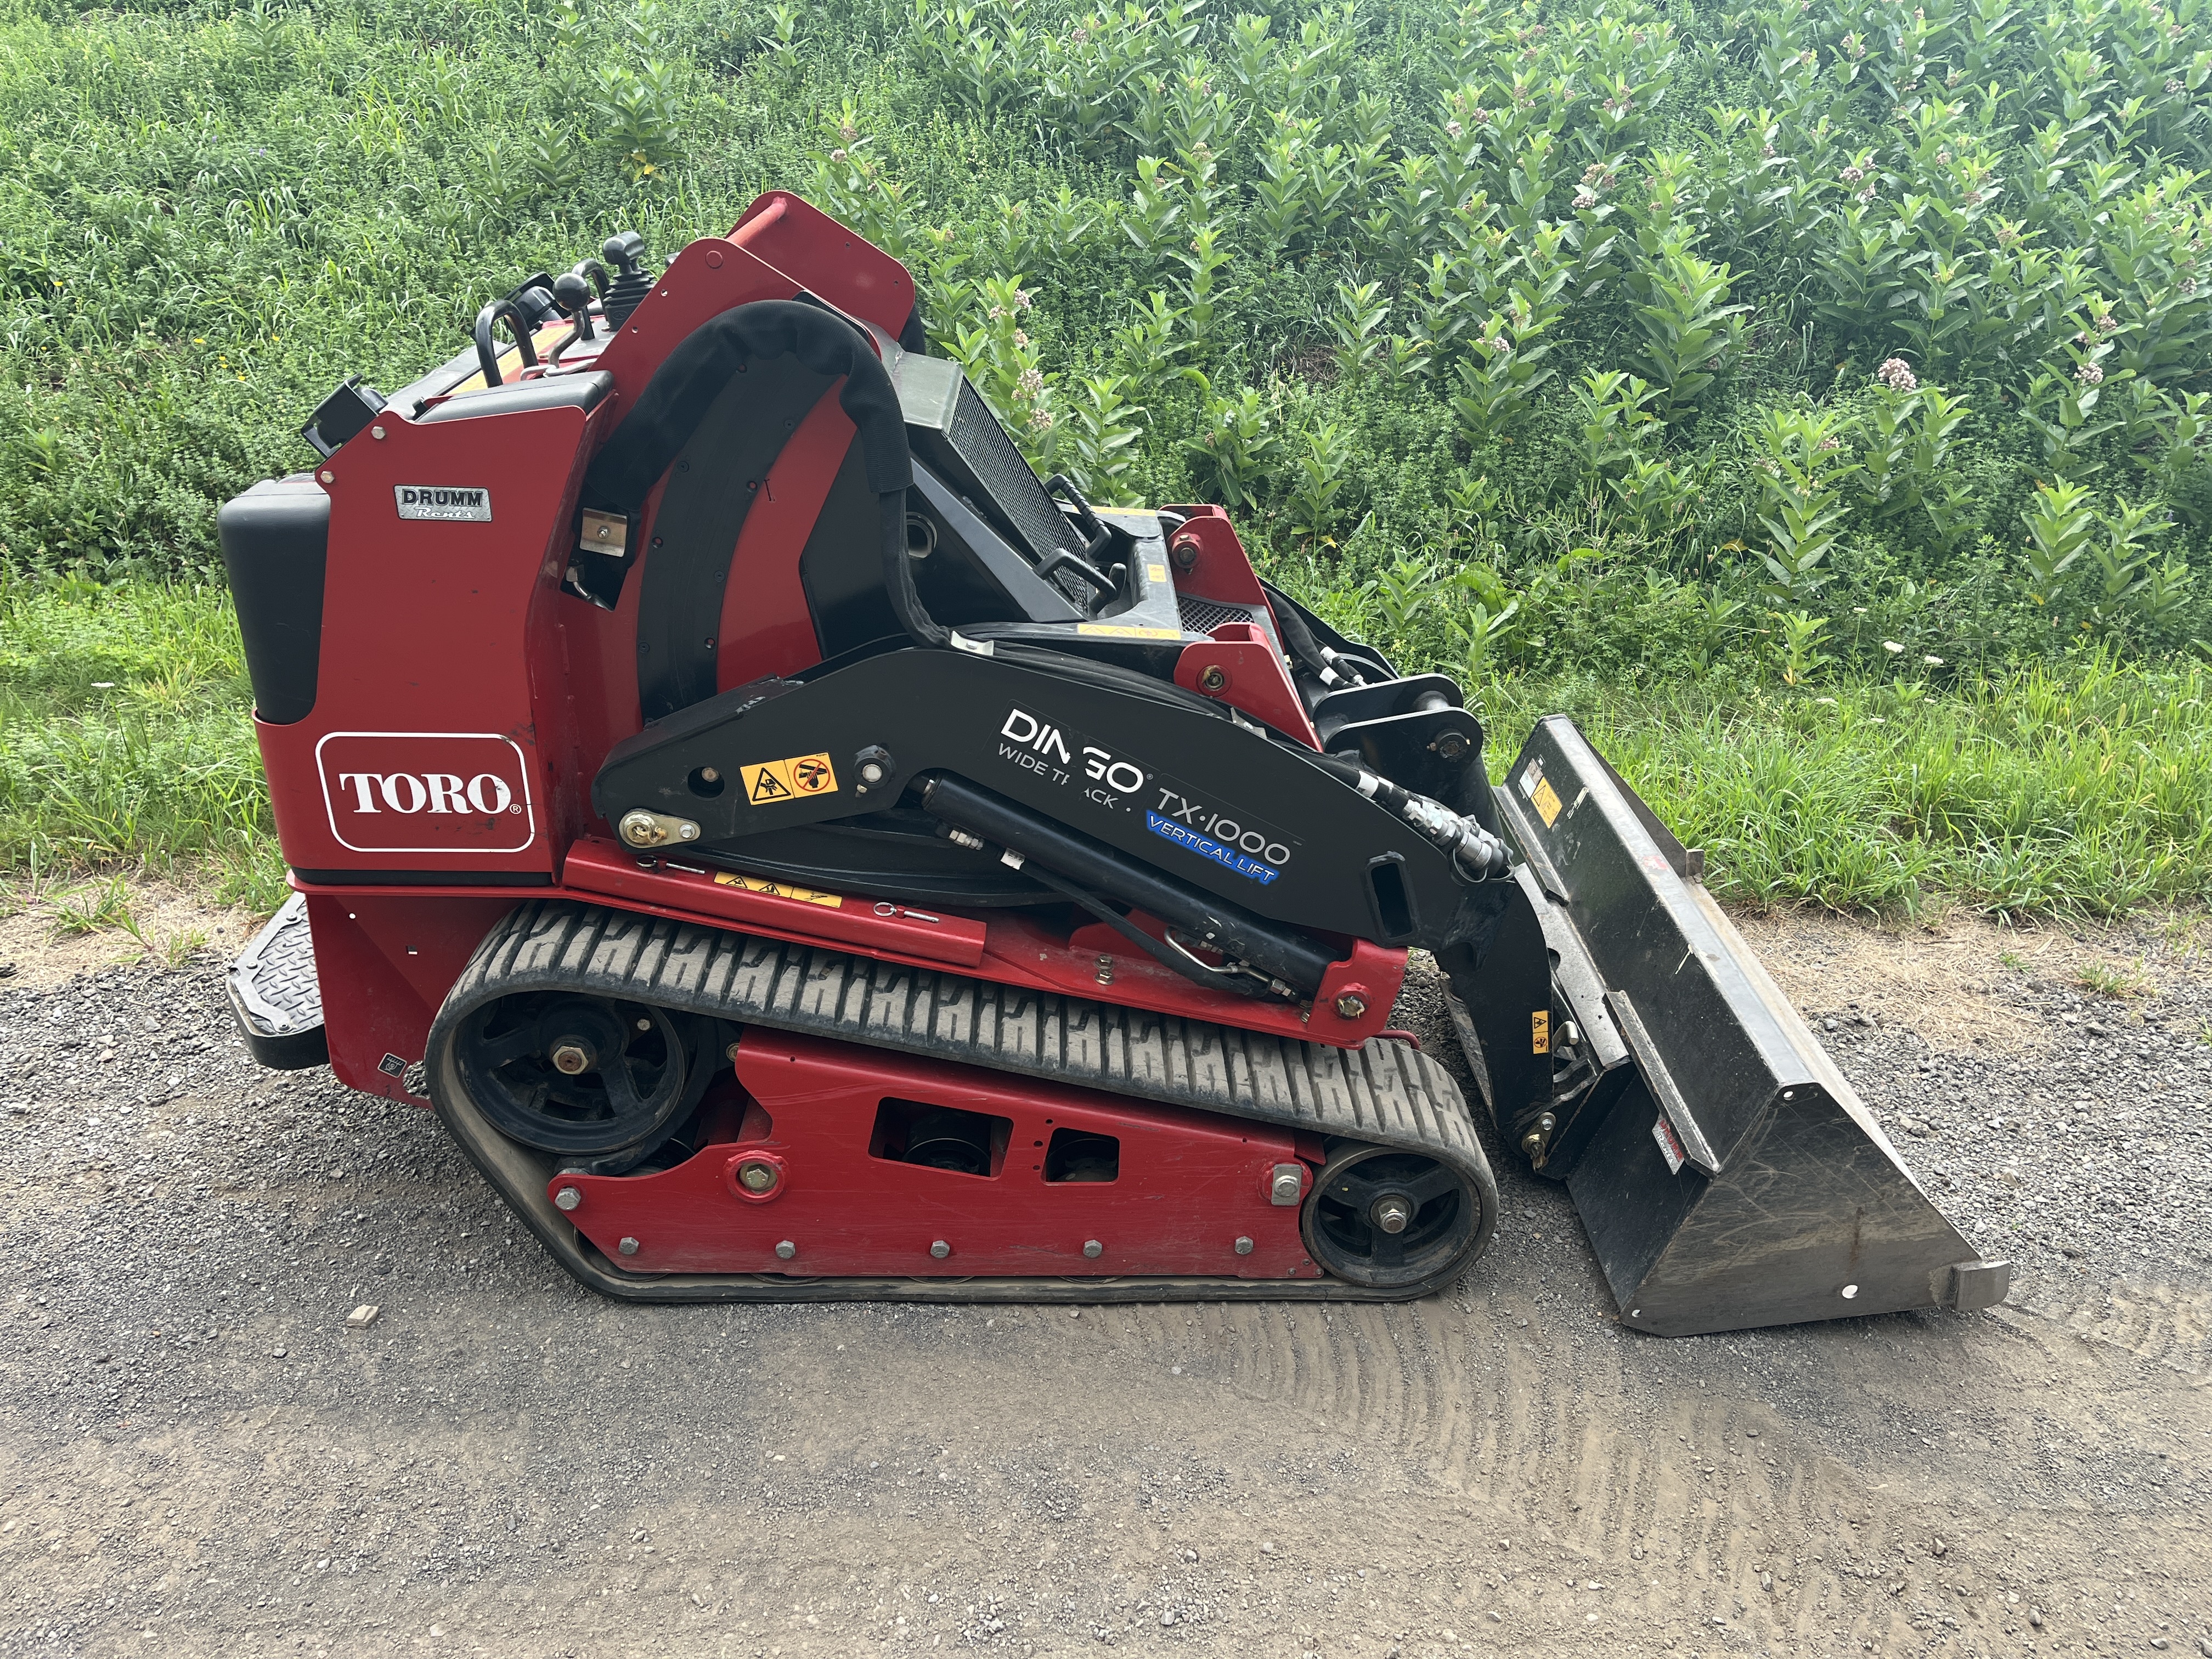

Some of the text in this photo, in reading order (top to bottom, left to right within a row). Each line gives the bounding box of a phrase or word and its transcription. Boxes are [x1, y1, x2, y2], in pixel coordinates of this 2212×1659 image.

[403, 489, 482, 506] DRUMM
[414, 507, 475, 518] Rents
[998, 743, 1048, 776] WIDE
[1149, 815, 1275, 881] VERTICAL LIFT
